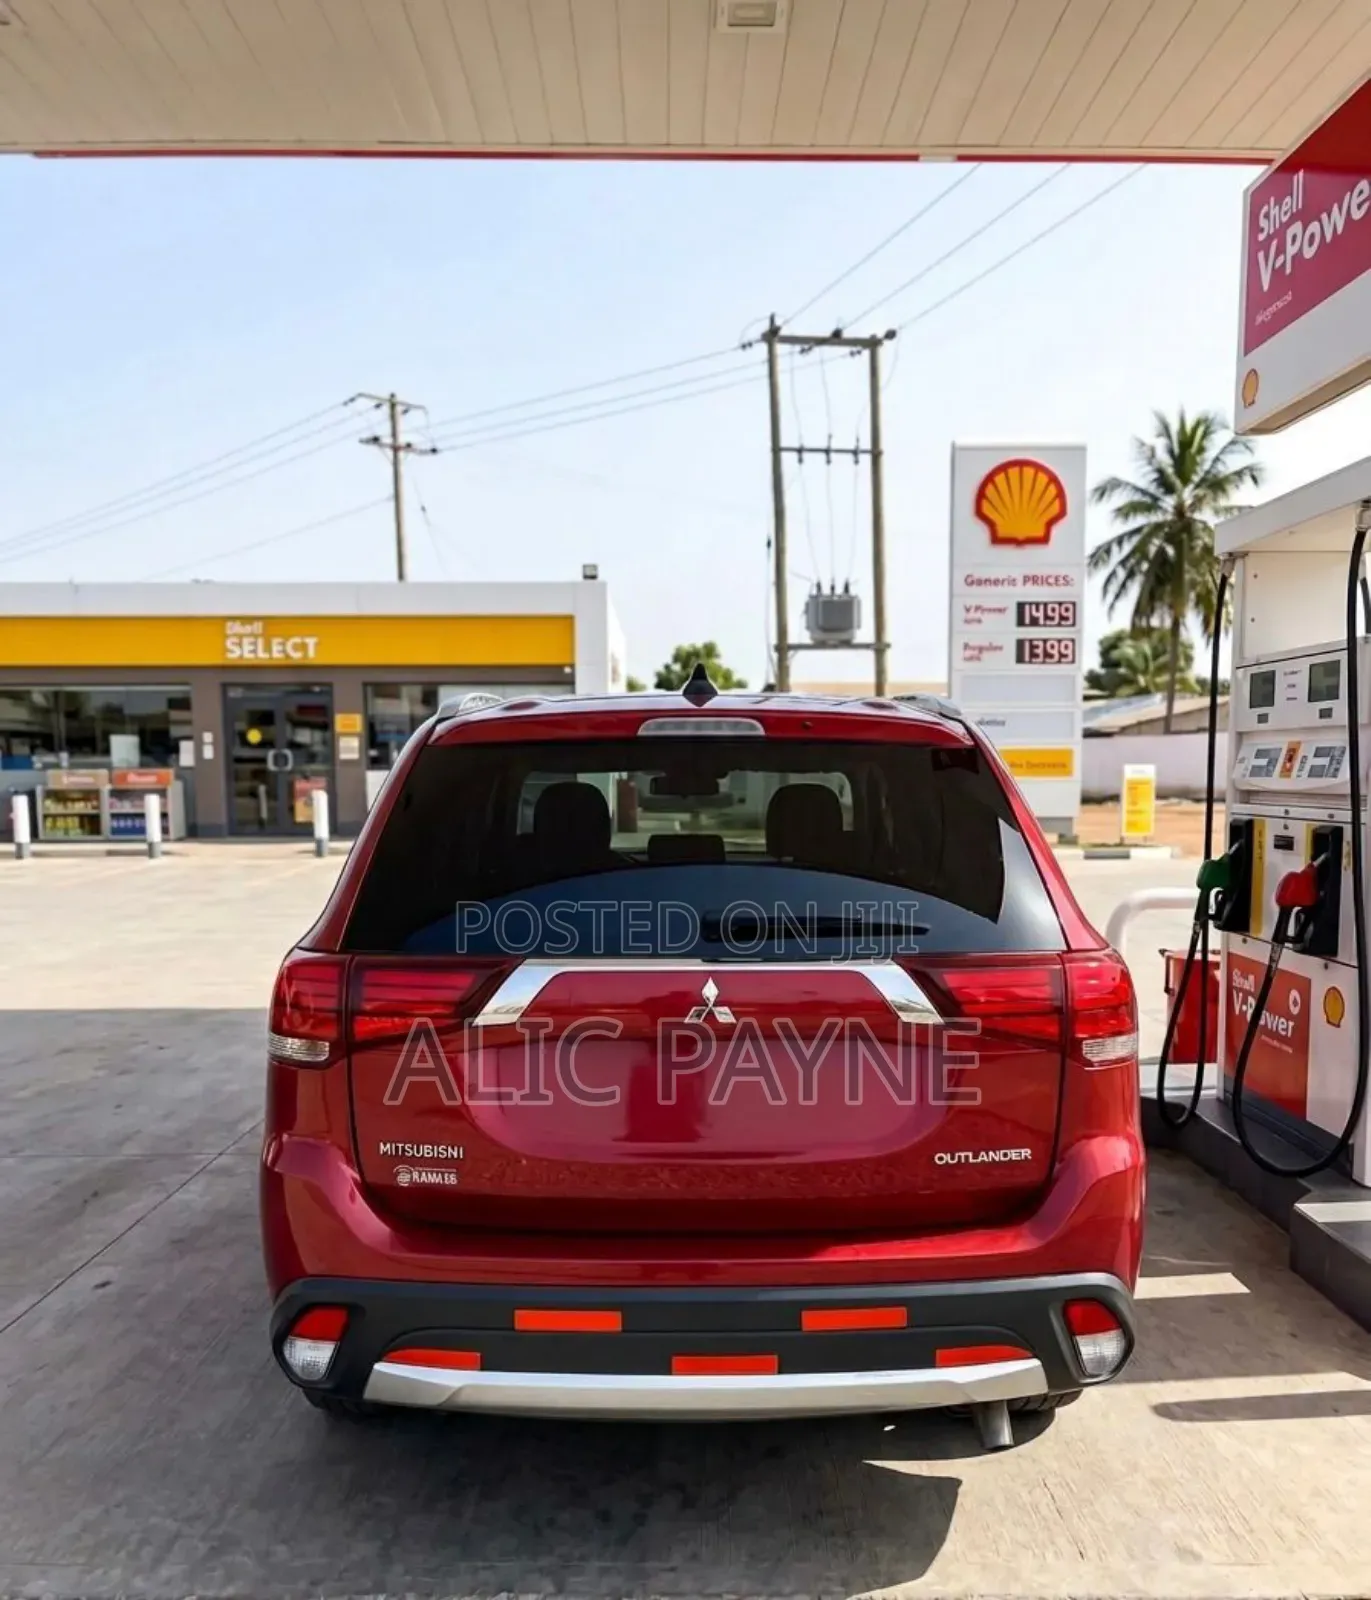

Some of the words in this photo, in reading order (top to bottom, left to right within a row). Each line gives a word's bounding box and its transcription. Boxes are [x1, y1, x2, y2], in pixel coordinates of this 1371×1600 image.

[1257, 169, 1304, 242] Shell
[225, 636, 319, 660] SELECT
[934, 1148, 1032, 1165] OUTLANDER
